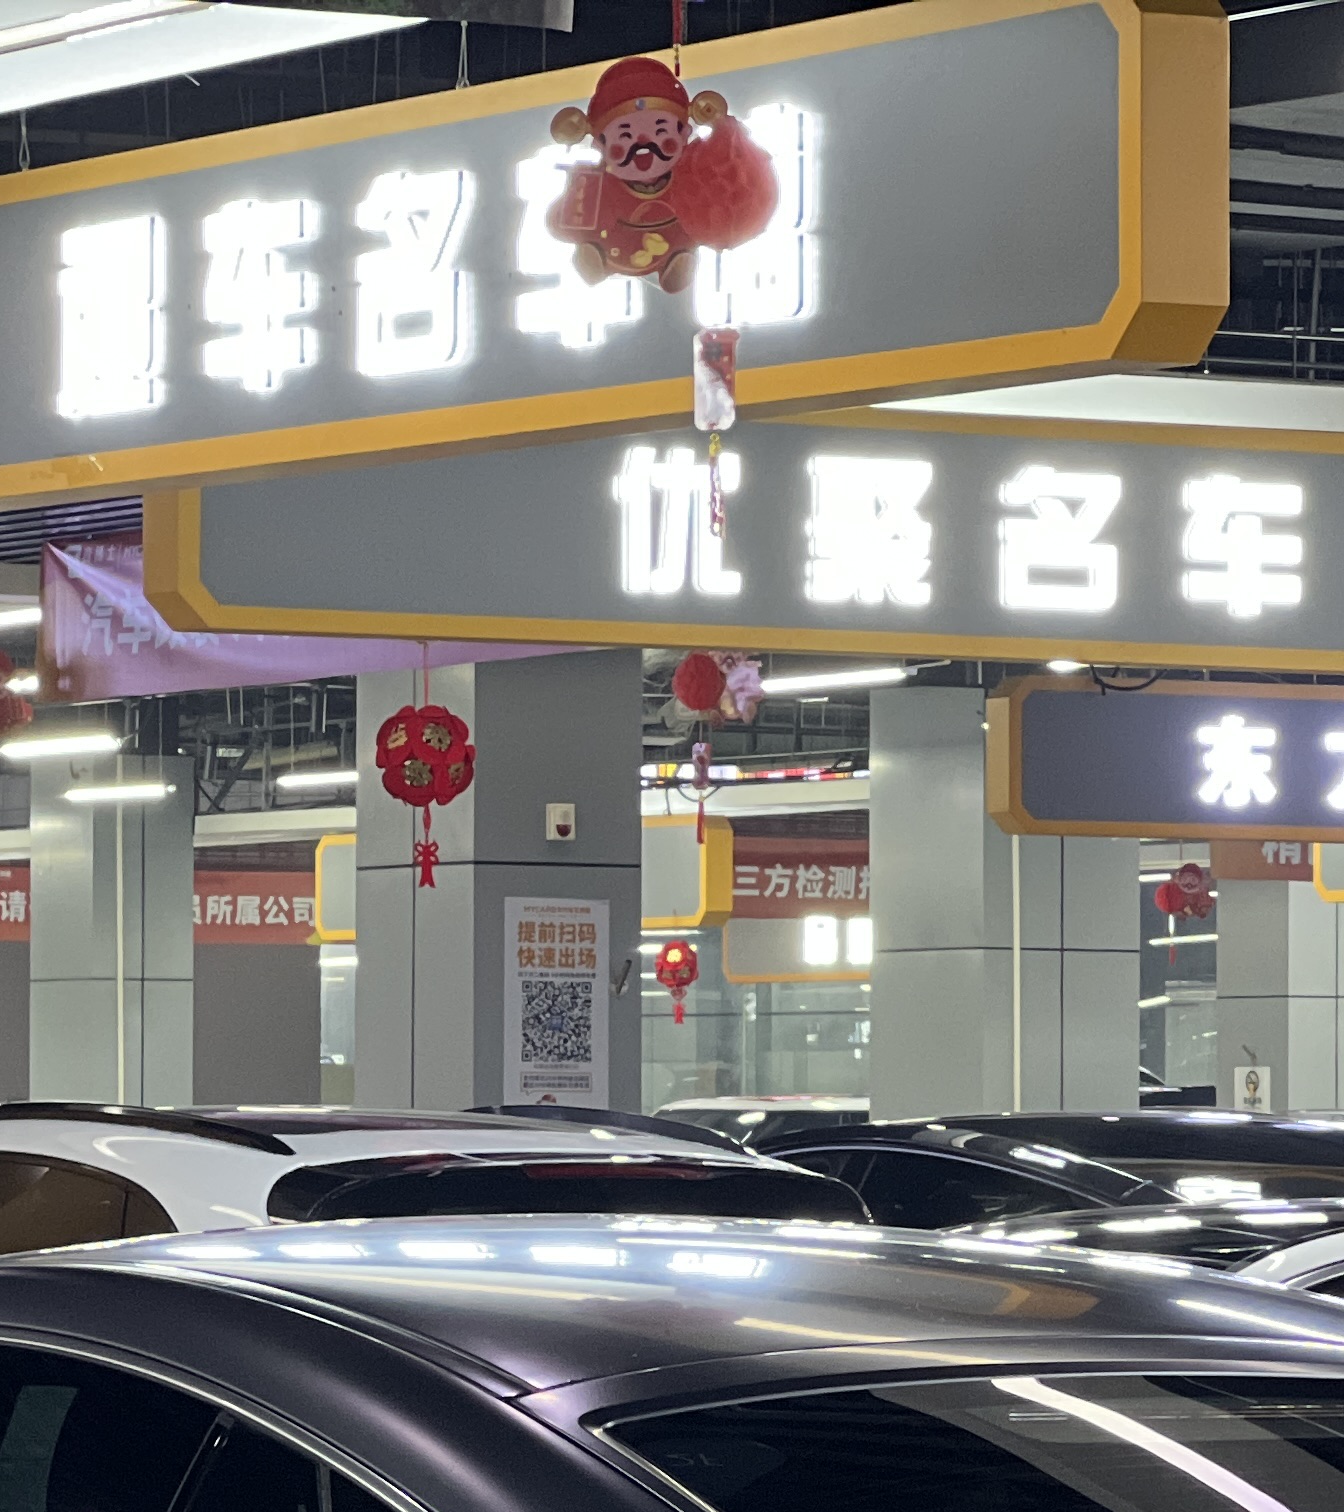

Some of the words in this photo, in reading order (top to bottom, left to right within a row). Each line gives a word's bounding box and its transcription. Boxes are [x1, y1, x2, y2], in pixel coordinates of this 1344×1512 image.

[612, 446, 1303, 617] 优聚名车
[518, 921, 596, 944] 提前扫码
[517, 946, 596, 969] 快速出场
